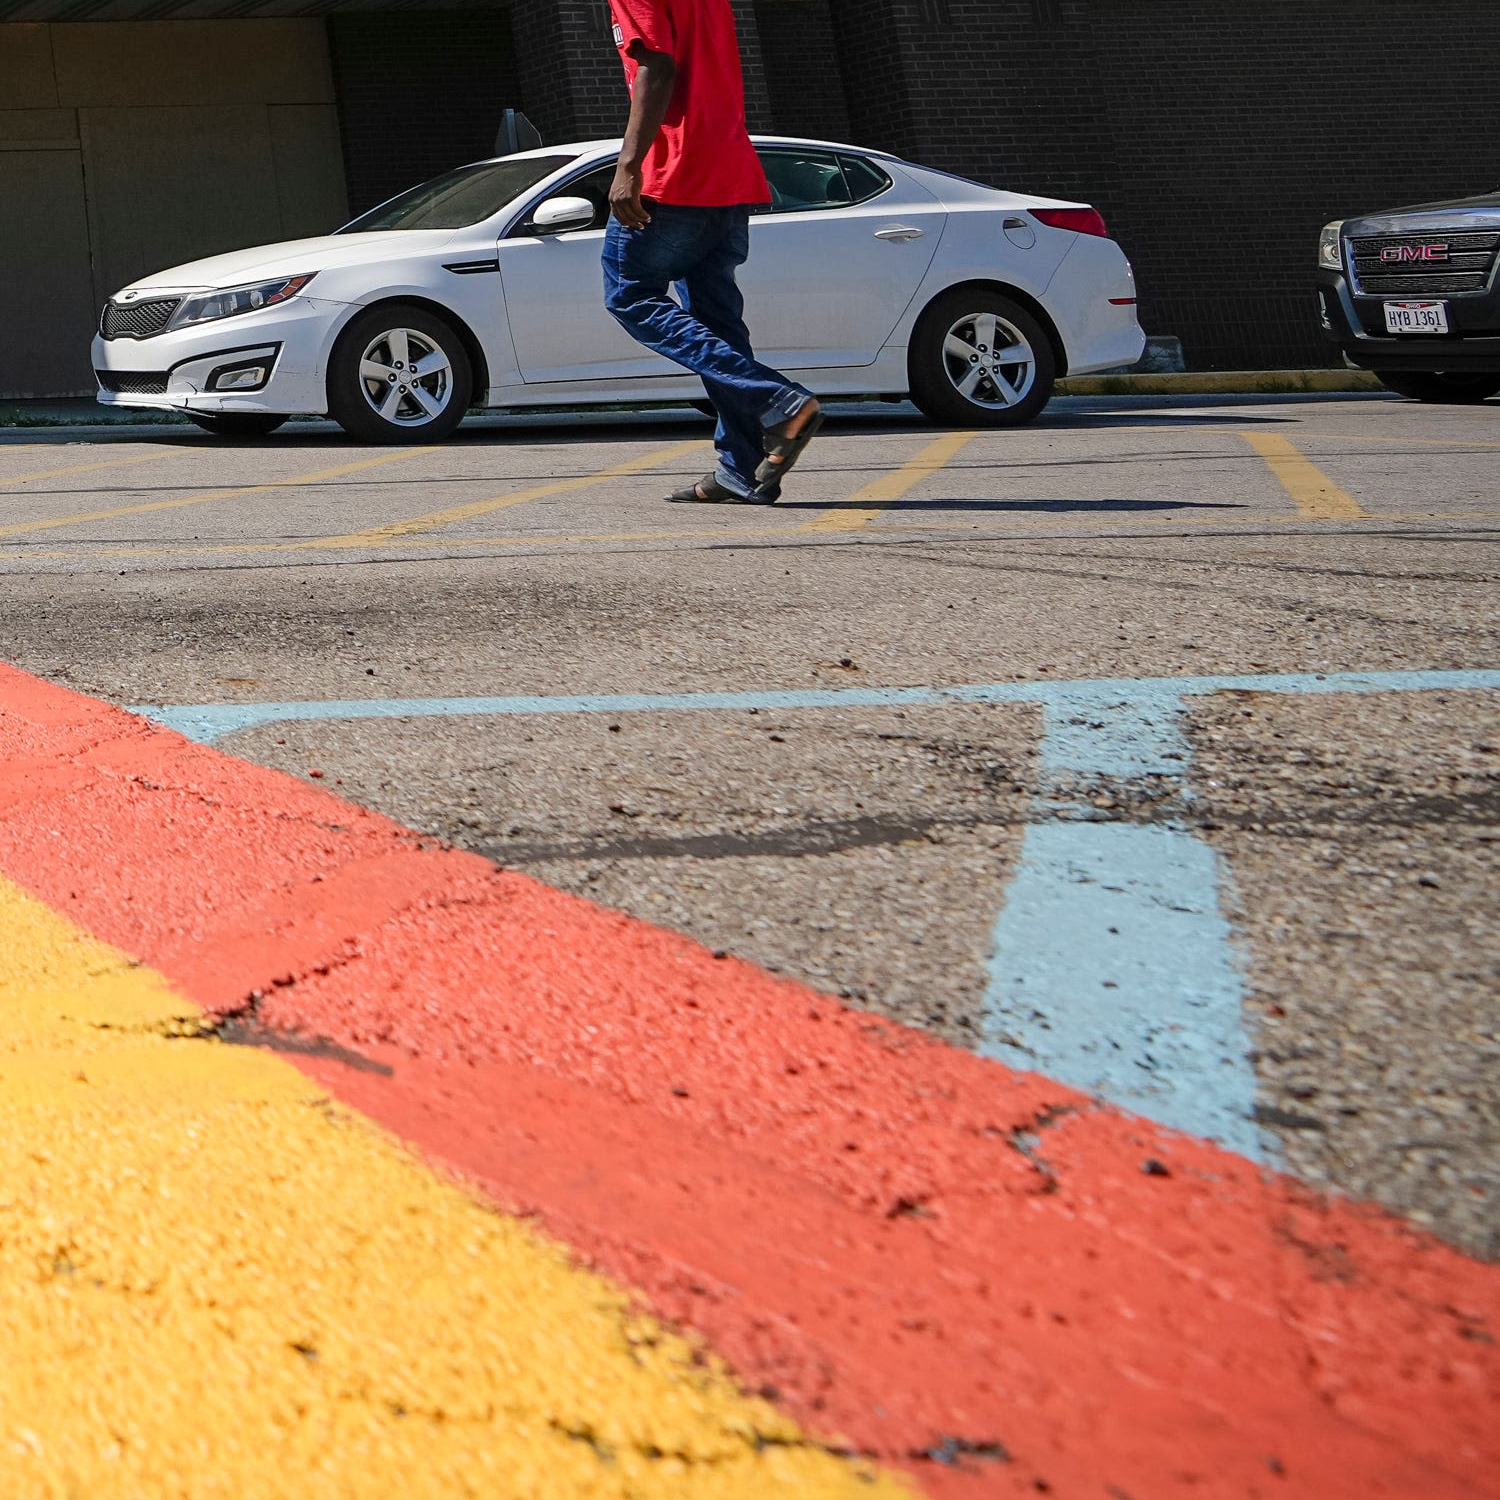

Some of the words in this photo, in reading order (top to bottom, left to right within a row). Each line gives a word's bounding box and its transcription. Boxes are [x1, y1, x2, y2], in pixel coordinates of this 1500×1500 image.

[1380, 244, 1448, 261] GMC
[1388, 311, 1411, 326] HYB
[1414, 311, 1442, 326] 1361
